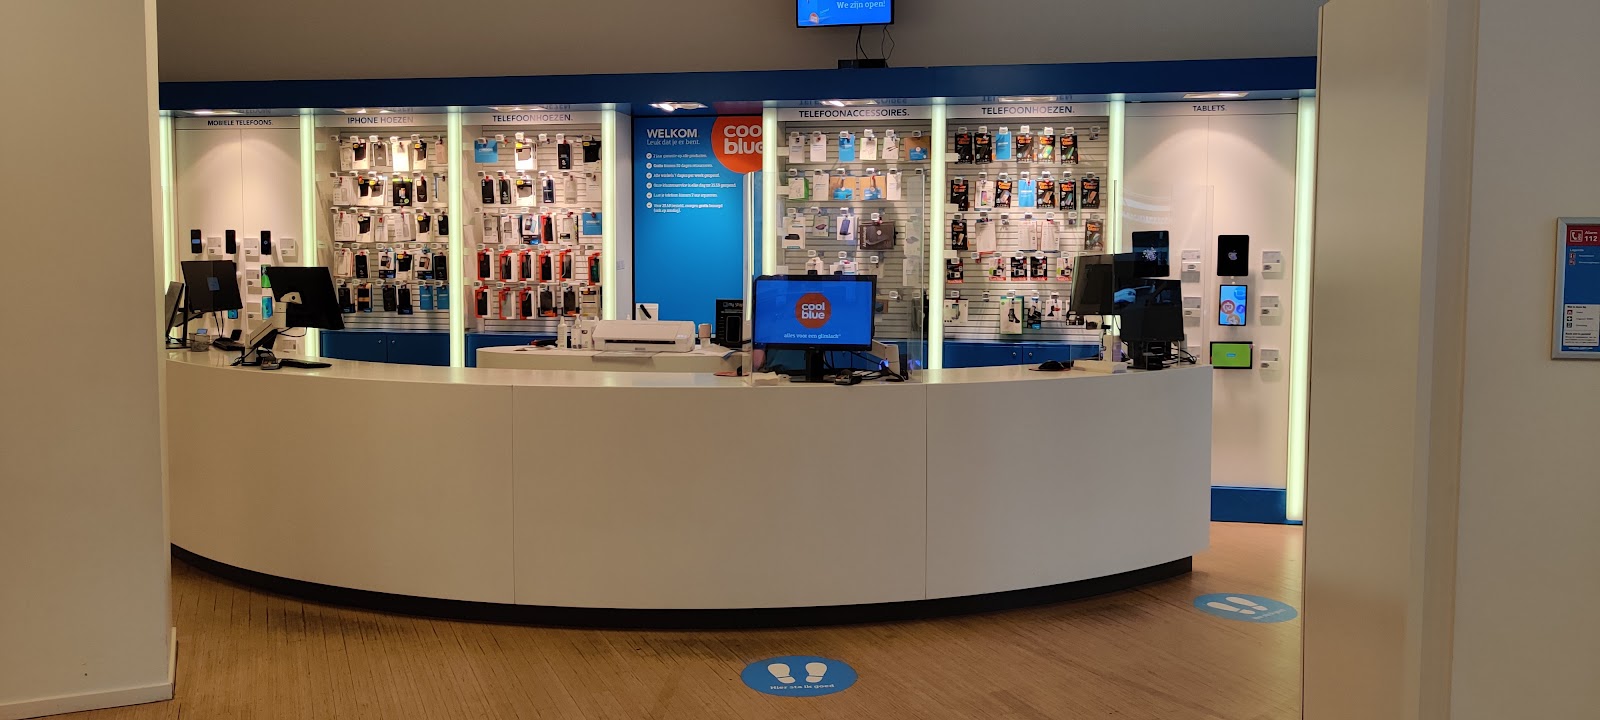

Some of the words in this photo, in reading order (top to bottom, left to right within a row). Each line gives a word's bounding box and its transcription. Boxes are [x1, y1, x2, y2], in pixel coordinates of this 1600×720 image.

[836, 1, 849, 9] We
[849, 1, 864, 10] zijn
[864, 0, 886, 9] open!
[799, 108, 910, 118] TELEFOONACCESSOIRES.
[981, 105, 1075, 115] TELEFOONHOEZEN.
[492, 114, 574, 122] TELEFOONHOEZEN.
[723, 124, 763, 138] coo
[801, 302, 826, 311] cool
[801, 310, 826, 320] blue
